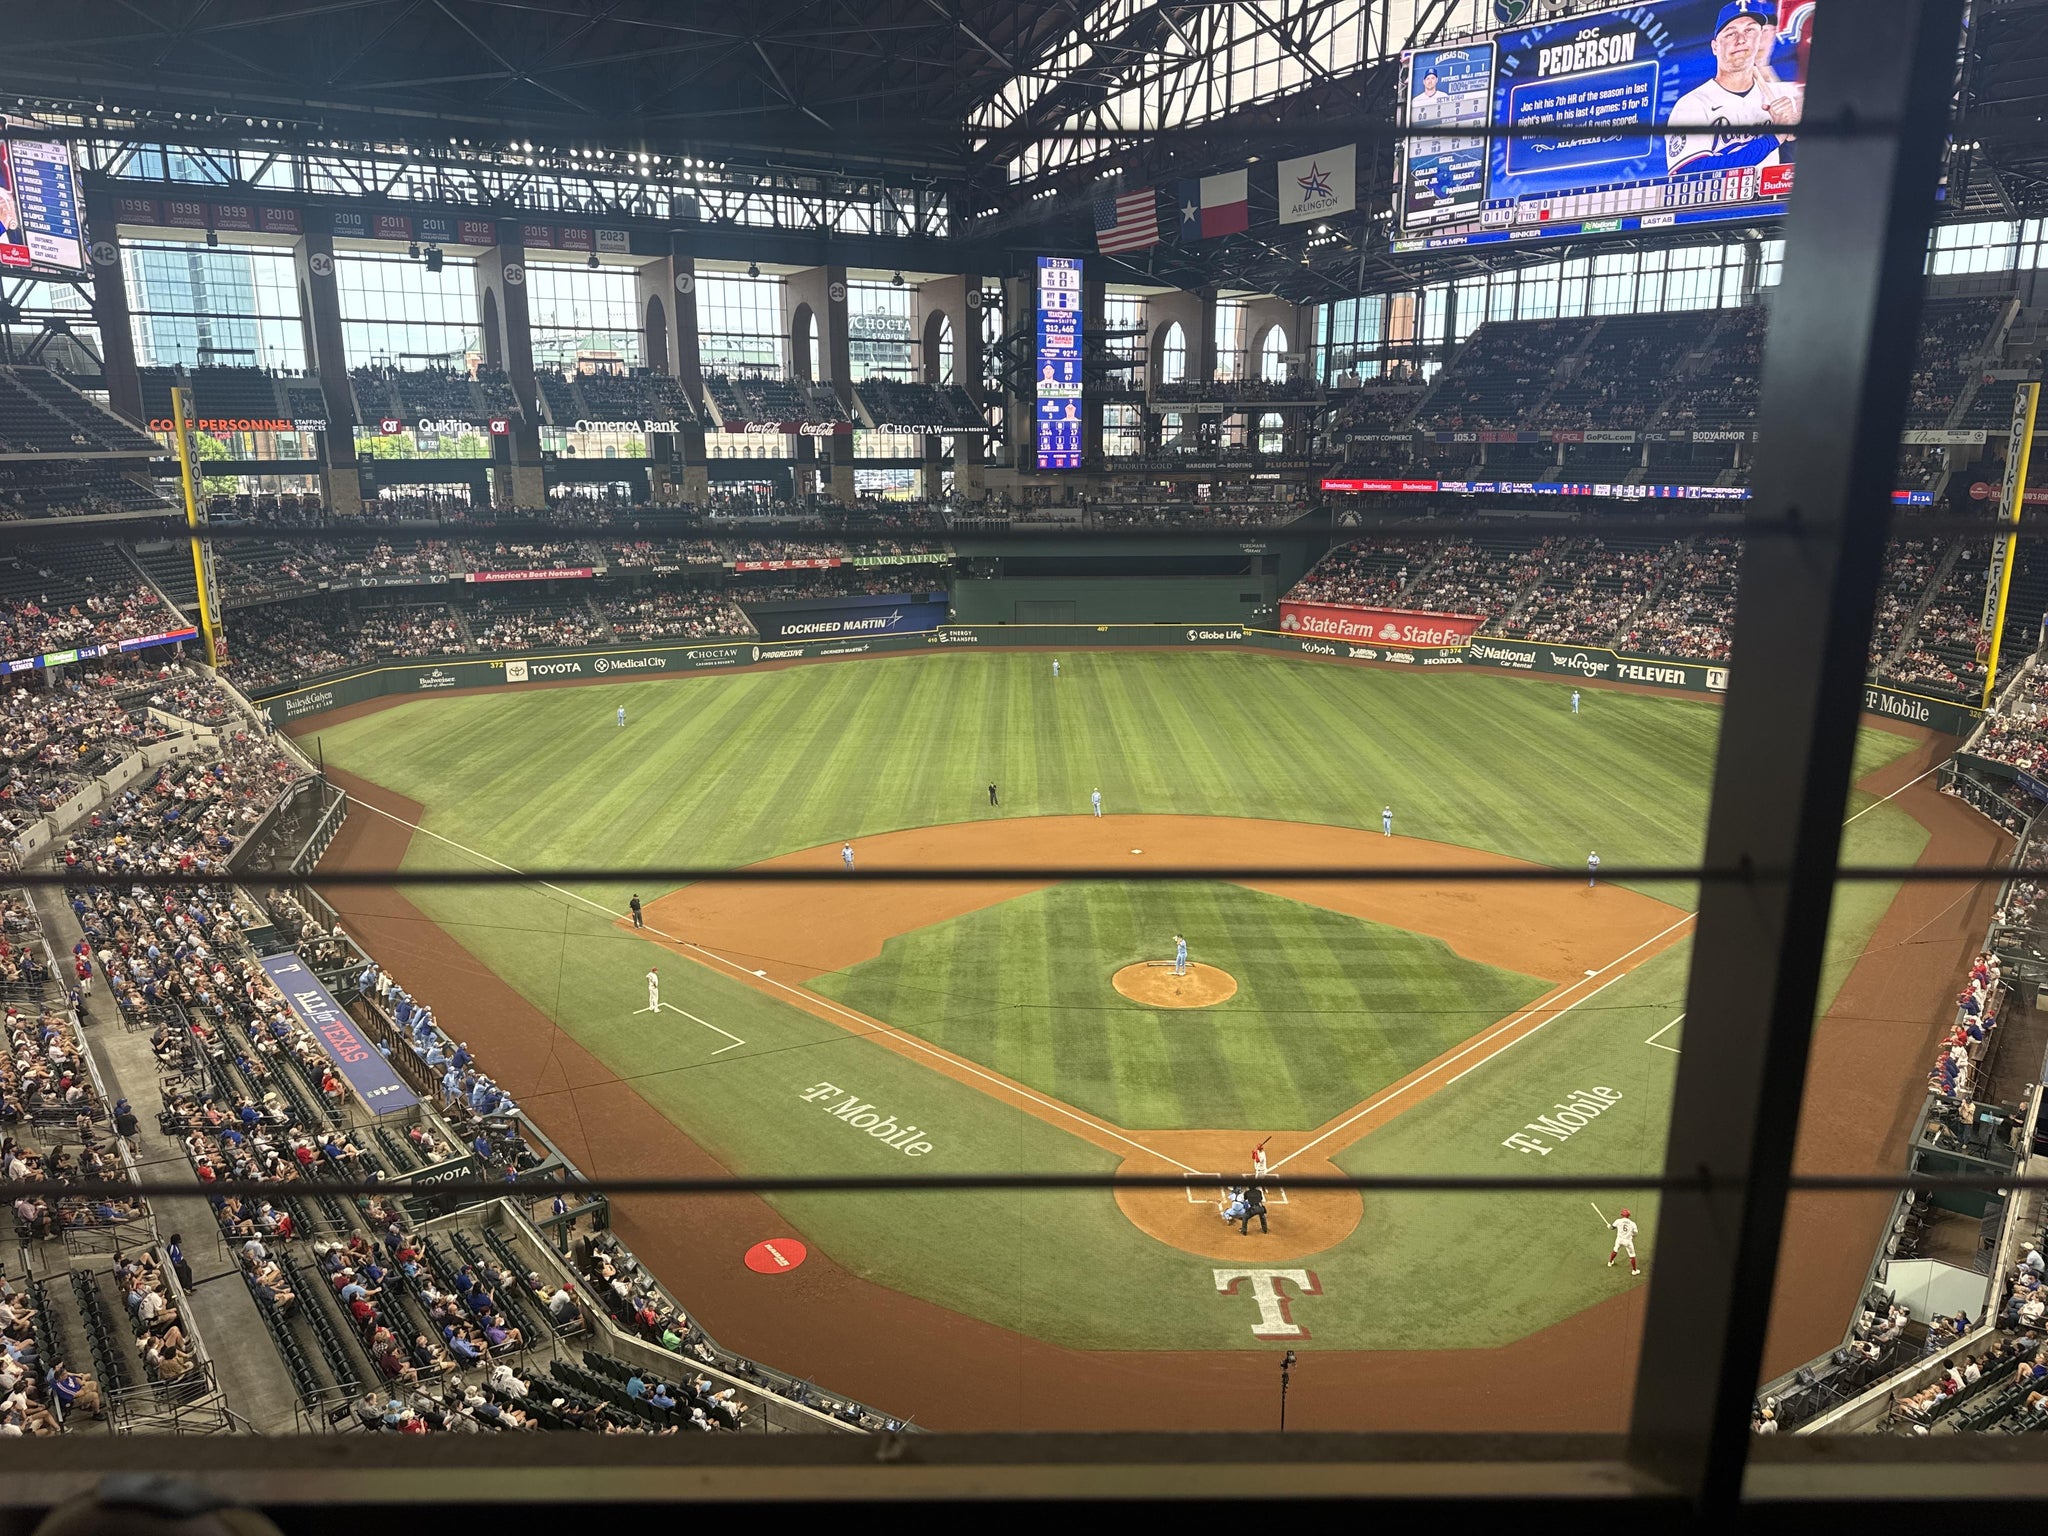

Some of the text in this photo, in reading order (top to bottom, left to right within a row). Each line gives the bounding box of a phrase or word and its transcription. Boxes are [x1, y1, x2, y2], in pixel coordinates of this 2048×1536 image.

[1576, 27, 1600, 41] JOC
[1435, 51, 1470, 65] KANSAS CITY
[1538, 32, 1637, 76] PEDERSON
[1450, 81, 1468, 92] 100%
[1521, 83, 1648, 112] Joc hit his 7th HR of the season in last
[1517, 96, 1649, 128] night's win. In his last 4 games: 5 for 15
[1612, 113, 1639, 127] scored.
[1415, 167, 1438, 176] COLLINS
[1453, 171, 1475, 180] MASSEY
[1414, 179, 1429, 187] WITT
[120, 199, 150, 212] 1996
[171, 202, 200, 215] 1998
[218, 205, 247, 218] 1999
[1292, 197, 1338, 214] ARLINGTON
[1529, 201, 1538, 210] KC
[266, 208, 294, 221] 2010
[335, 213, 361, 225] 2010
[381, 216, 405, 228] 2011
[423, 219, 445, 231] 2011
[464, 222, 489, 233] 2012
[524, 226, 548, 237] 2015
[564, 228, 587, 239] 2016
[600, 230, 624, 242] 2023
[1430, 239, 1447, 247] 89.4
[1448, 237, 1468, 245] MPH
[1510, 230, 1541, 239] SINKER
[1643, 217, 1660, 225] LAST
[95, 246, 116, 263] 42
[312, 257, 331, 271] 34
[1052, 260, 1069, 268] 3:14
[506, 268, 522, 281] 26
[681, 277, 689, 289] 7
[831, 286, 844, 297] 29
[969, 294, 979, 305] 10
[854, 316, 911, 332] CHOCTA
[1046, 324, 1074, 333] $12,465
[150, 419, 194, 432] COE
[200, 419, 294, 432] PERSONNEL
[382, 419, 506, 434] QT QuikTrip QT
[644, 420, 680, 433] Bank
[800, 422, 836, 436] Coca-Cola
[885, 424, 943, 435] CHOCTAW
[1380, 434, 1413, 442] COMMERCE
[1453, 433, 1477, 442] 105.3
[1561, 433, 1581, 441] PGL
[1586, 433, 1632, 442] GoPGL.com
[1644, 433, 1666, 441] PGL
[1692, 431, 1745, 440] BODYARMOR
[1914, 431, 1942, 443] Thai
[188, 434, 201, 496] ROOT
[1151, 462, 1172, 470] GOLD
[2002, 422, 2022, 516] CHIKIN
[863, 554, 947, 566] LUXOR STAFFING
[485, 569, 583, 580] America's Best Network
[226, 598, 246, 608] SHIFT
[275, 591, 292, 600] SHIFT
[1985, 565, 2001, 628] FARE
[781, 619, 886, 635] LOCKHEED MARTIN
[1199, 630, 1242, 640] Globe Life
[692, 649, 738, 659] CHOCTAW
[761, 649, 804, 659] PROGRESSIVE
[1302, 642, 1336, 655] Kubota
[1484, 646, 1536, 663] National
[531, 663, 582, 675] TOYOTA
[611, 657, 666, 670] Medical City
[1568, 652, 1610, 677] Kroger
[419, 677, 456, 685] Budweiser
[287, 706, 315, 717] ATTORNEYS
[1879, 693, 1930, 722] Mobile
[1969, 709, 1982, 718] 326
[294, 990, 327, 1015] ALL
[320, 1020, 369, 1063] TEXAS
[1524, 1086, 1623, 1142] Mobile
[822, 1095, 933, 1157] Mobile
[1213, 1268, 1324, 1340] T
